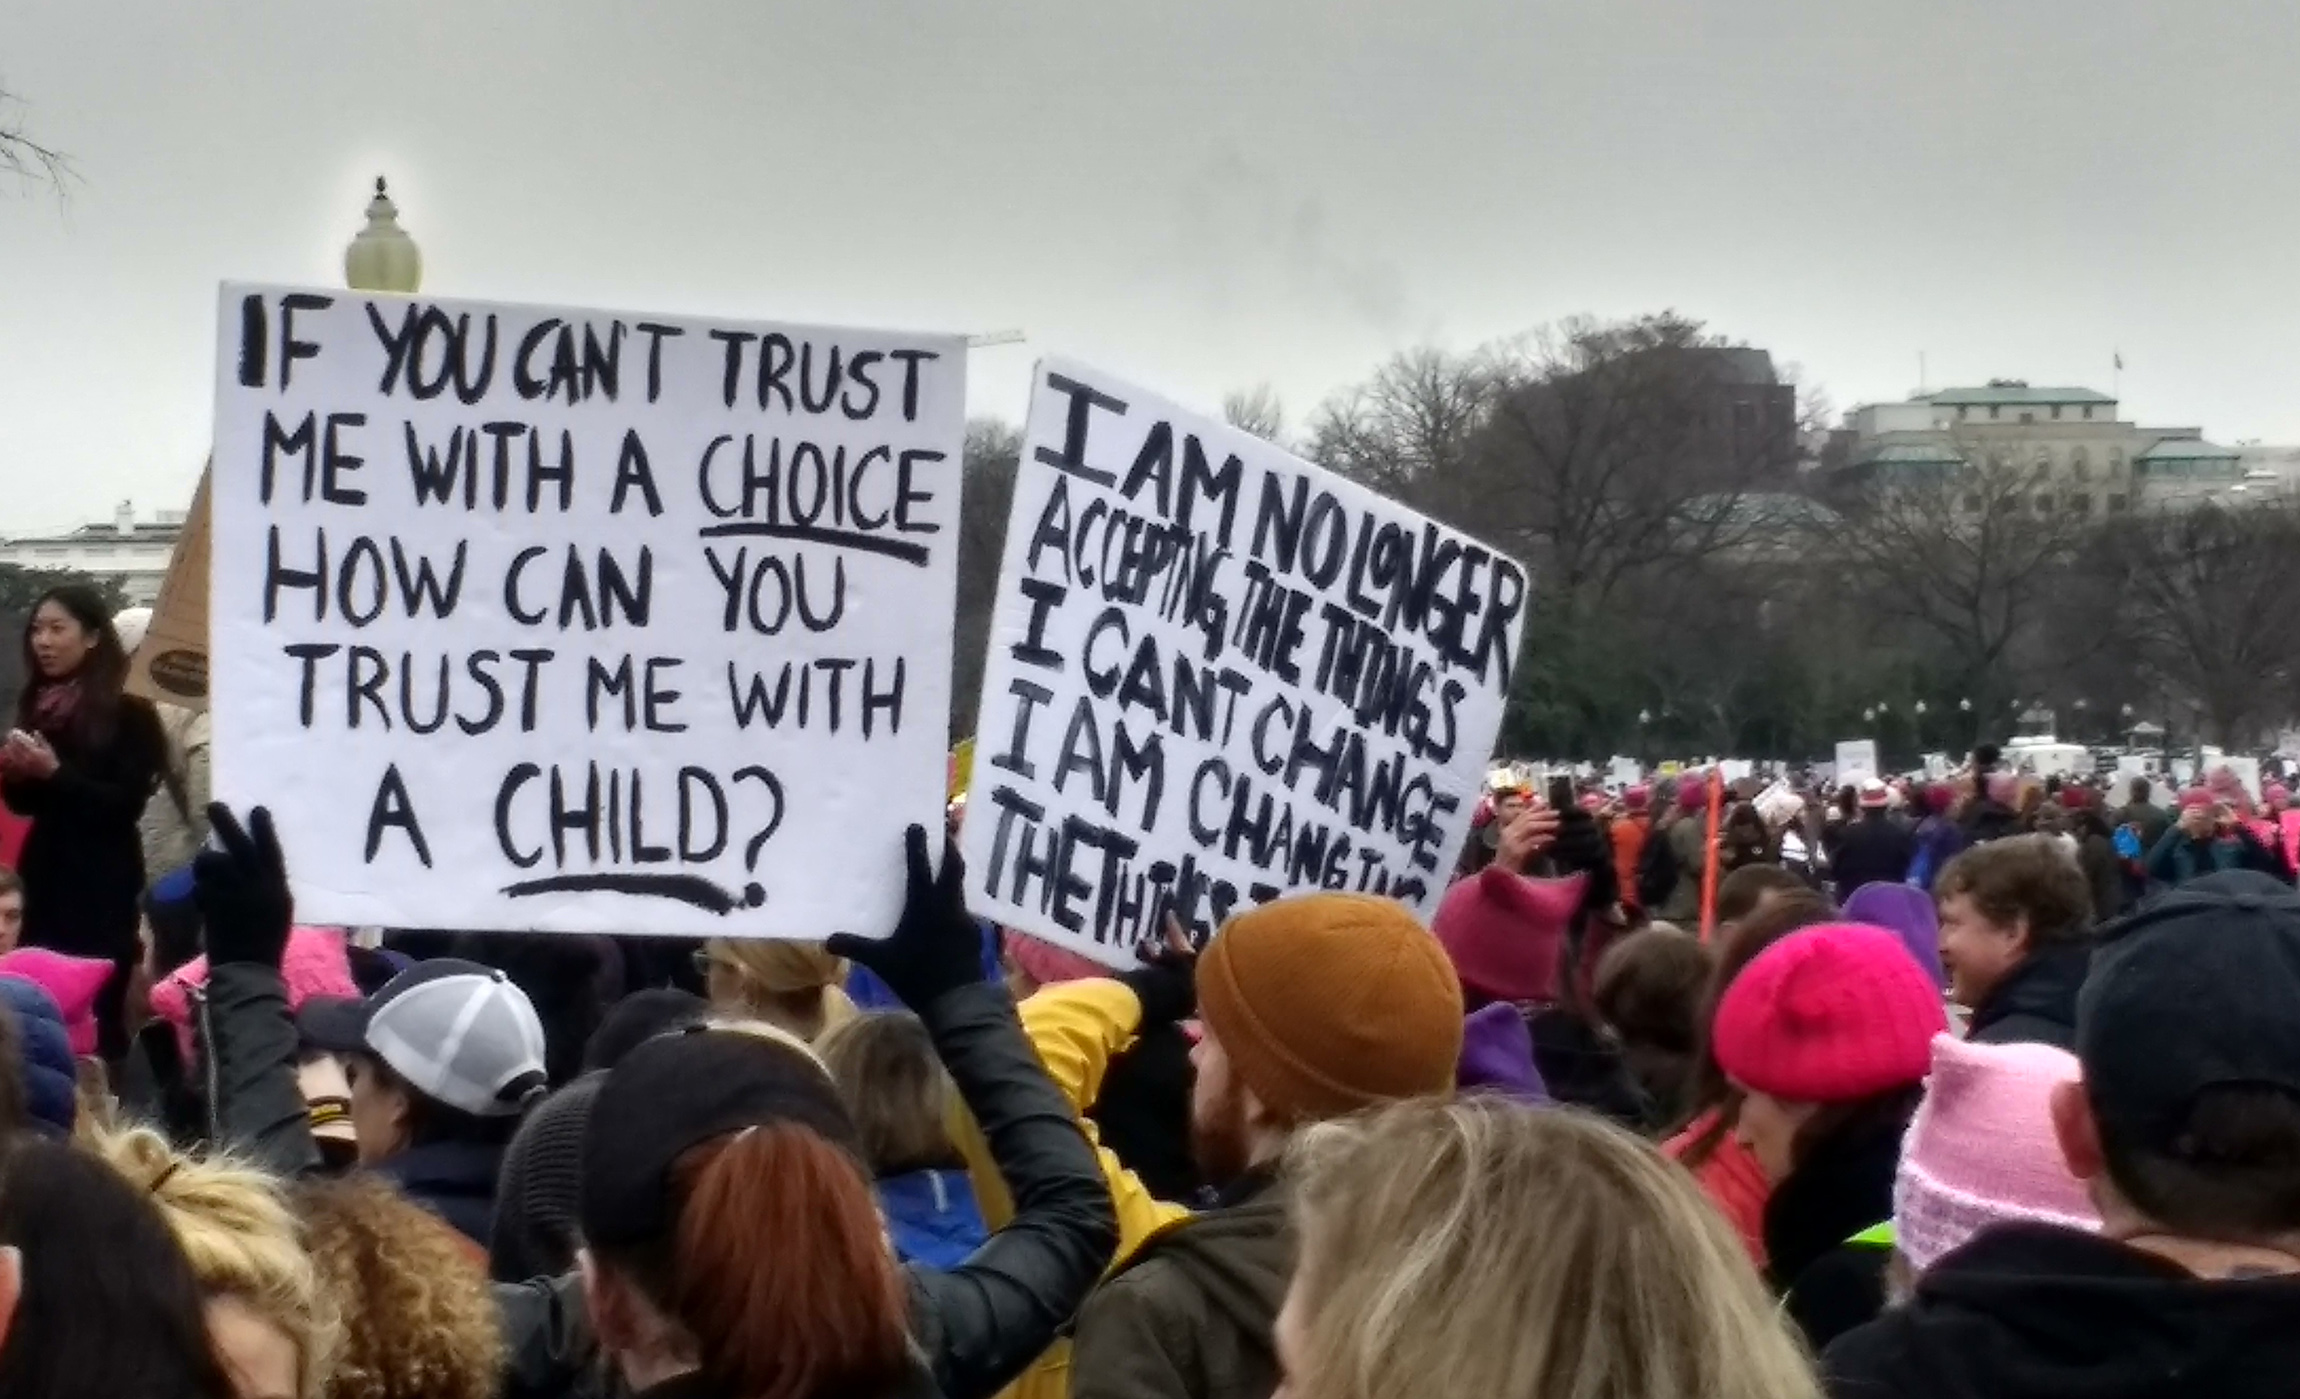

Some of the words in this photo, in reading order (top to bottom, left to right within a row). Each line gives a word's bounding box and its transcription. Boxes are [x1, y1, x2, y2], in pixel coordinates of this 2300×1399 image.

[238, 294, 334, 393] IF
[366, 301, 497, 405] YOU
[513, 317, 686, 406] CAN'T
[709, 329, 940, 422] TRUST
[261, 410, 367, 507] ME
[404, 420, 573, 513] WITH
[610, 428, 664, 516] A
[699, 434, 946, 532] CHOICE
[1034, 371, 1129, 489] I
[1118, 420, 1244, 552] AM
[1249, 469, 1348, 592] NO
[1346, 511, 1525, 700] LONGER
[263, 524, 467, 627] HOW
[505, 543, 652, 630] CAN
[704, 545, 845, 635] YOU
[283, 644, 555, 735] TRUST
[587, 653, 687, 733] ME
[727, 656, 906, 741] WITH
[1010, 576, 1067, 674] I
[1082, 606, 1253, 749] CANT
[1251, 692, 1461, 873] CHANGE
[1230, 561, 1313, 688] THE
[1314, 602, 1466, 765] THINGS
[991, 677, 1054, 781] I
[1052, 695, 1165, 833] AM
[364, 763, 433, 869] A
[494, 760, 785, 907] CHILD?
